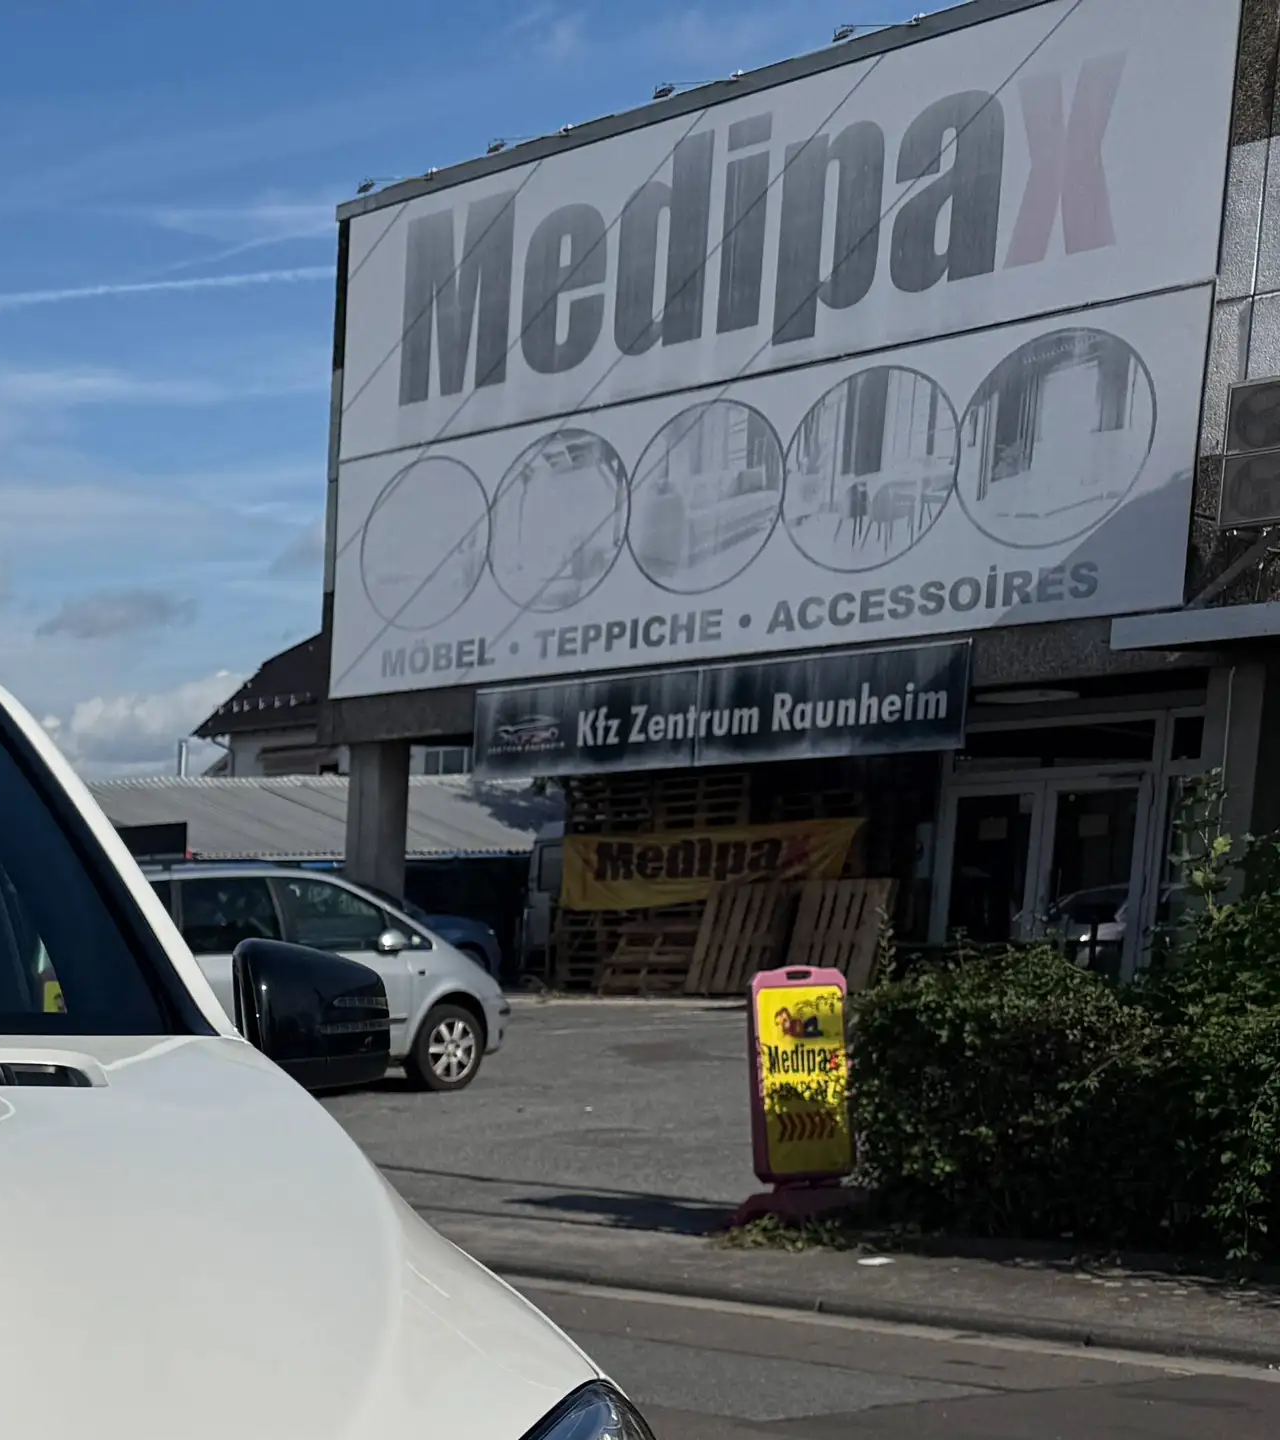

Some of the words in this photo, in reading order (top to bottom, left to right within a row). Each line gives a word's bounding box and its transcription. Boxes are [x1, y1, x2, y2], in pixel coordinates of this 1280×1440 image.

[399, 52, 1127, 406] Medipax
[381, 637, 495, 679] MÖBEL
[540, 609, 723, 660] TEPPICHE
[576, 706, 620, 748] Kfz
[628, 703, 759, 744] Zentrum
[771, 682, 948, 733] Raunheim
